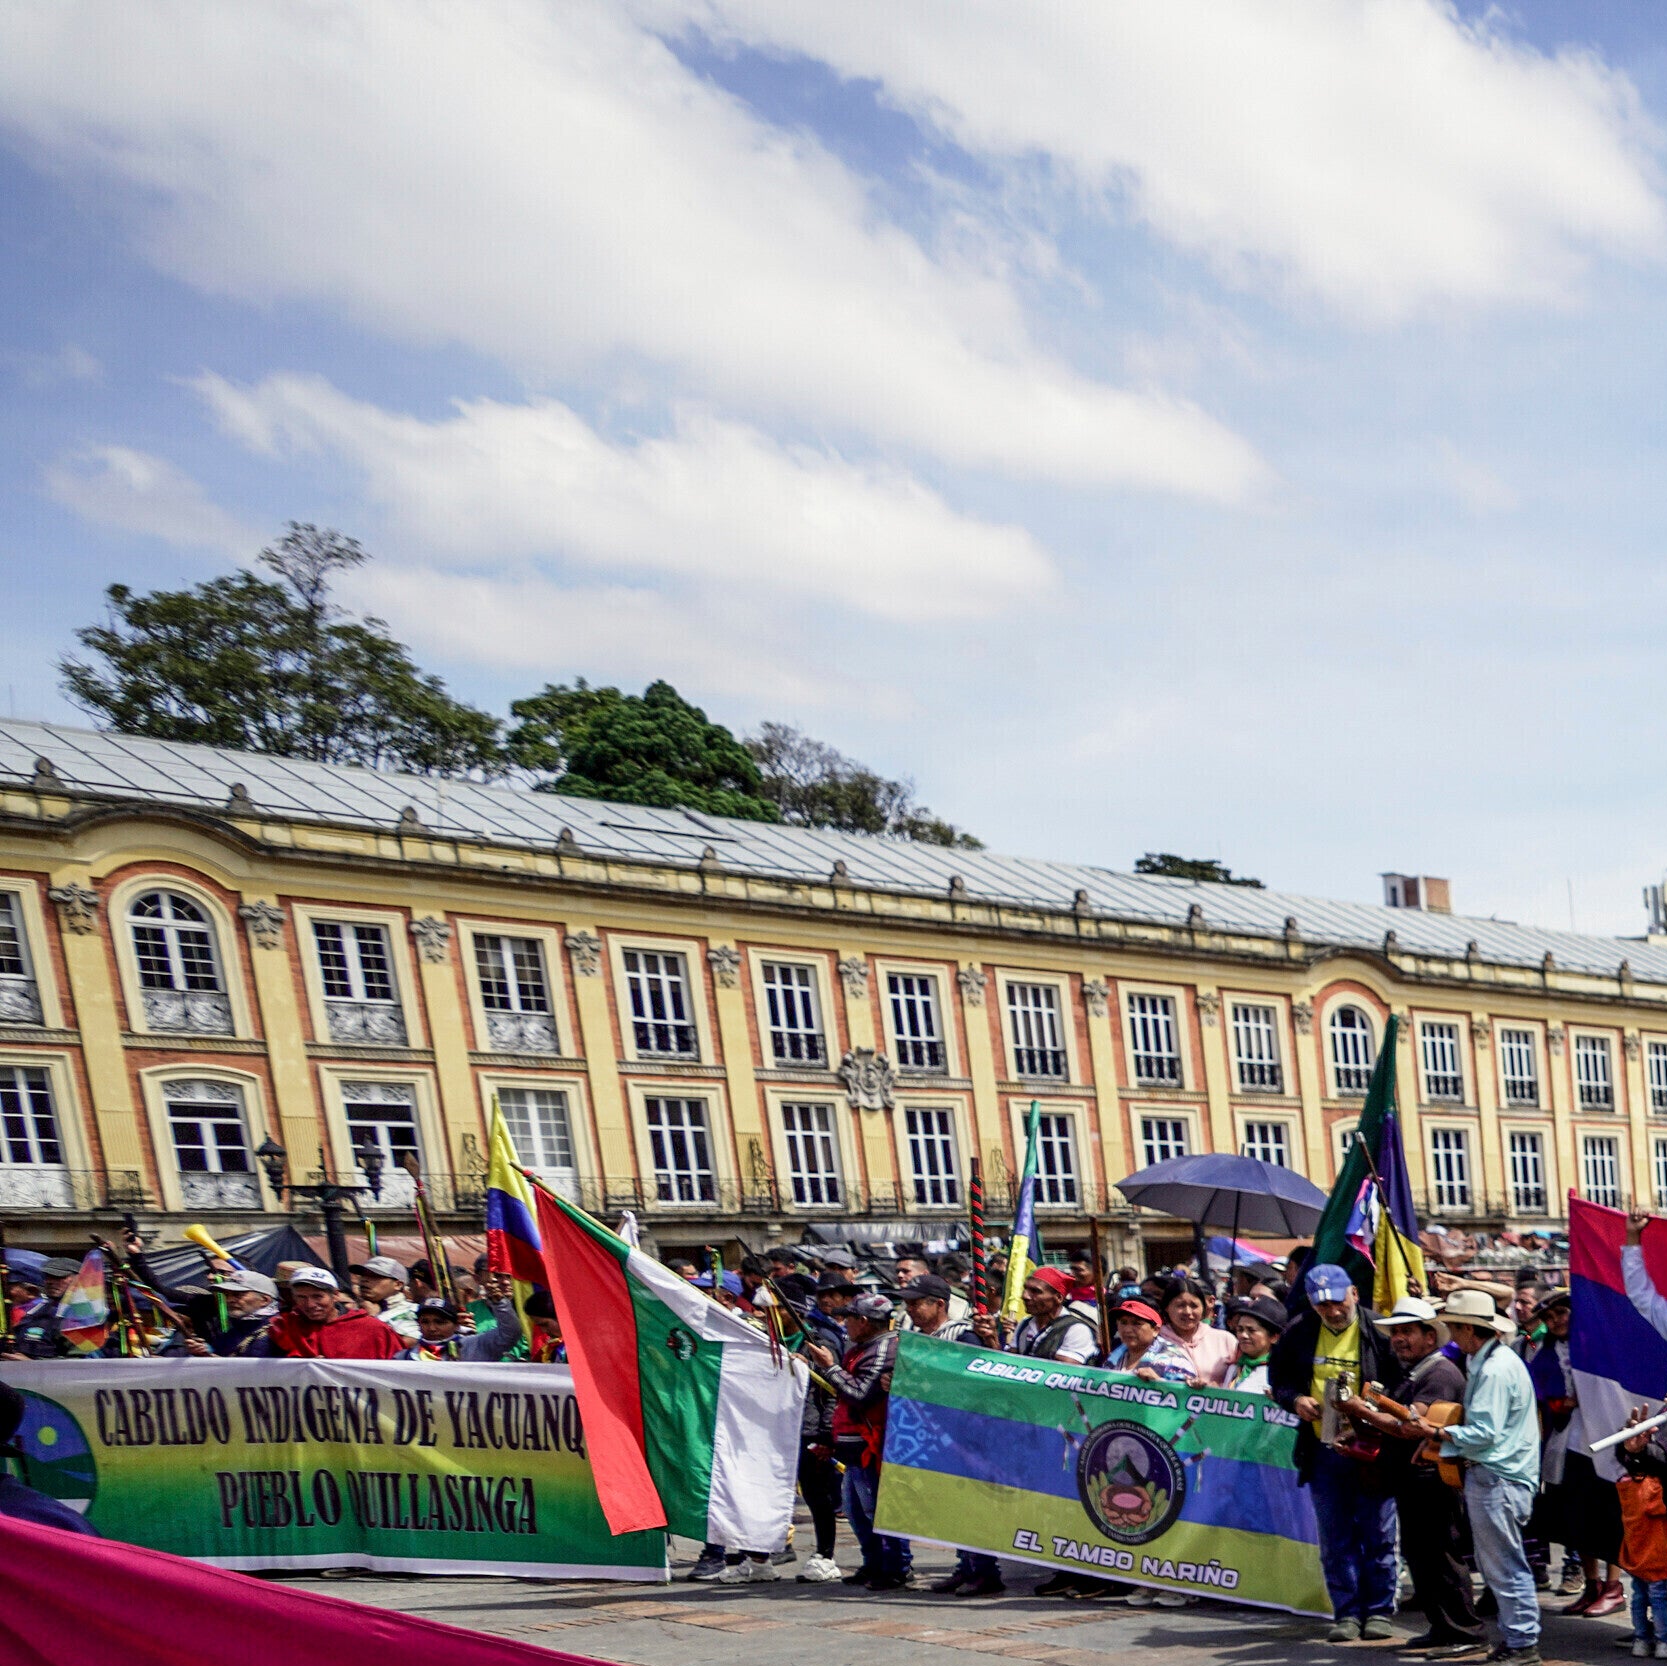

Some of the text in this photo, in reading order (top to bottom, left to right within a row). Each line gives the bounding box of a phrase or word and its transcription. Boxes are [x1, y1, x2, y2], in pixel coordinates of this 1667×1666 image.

[95, 1386, 230, 1448] CABILDO
[236, 1384, 379, 1445] INDIGENA
[393, 1391, 438, 1448] DE
[966, 1357, 1046, 1386] CABILDO
[1045, 1372, 1178, 1409] QUILLASINGA
[1186, 1395, 1255, 1420] QUILLA
[215, 1468, 343, 1529] PUEBLO
[1013, 1528, 1240, 1589] EL TAMBO NARIÑO
